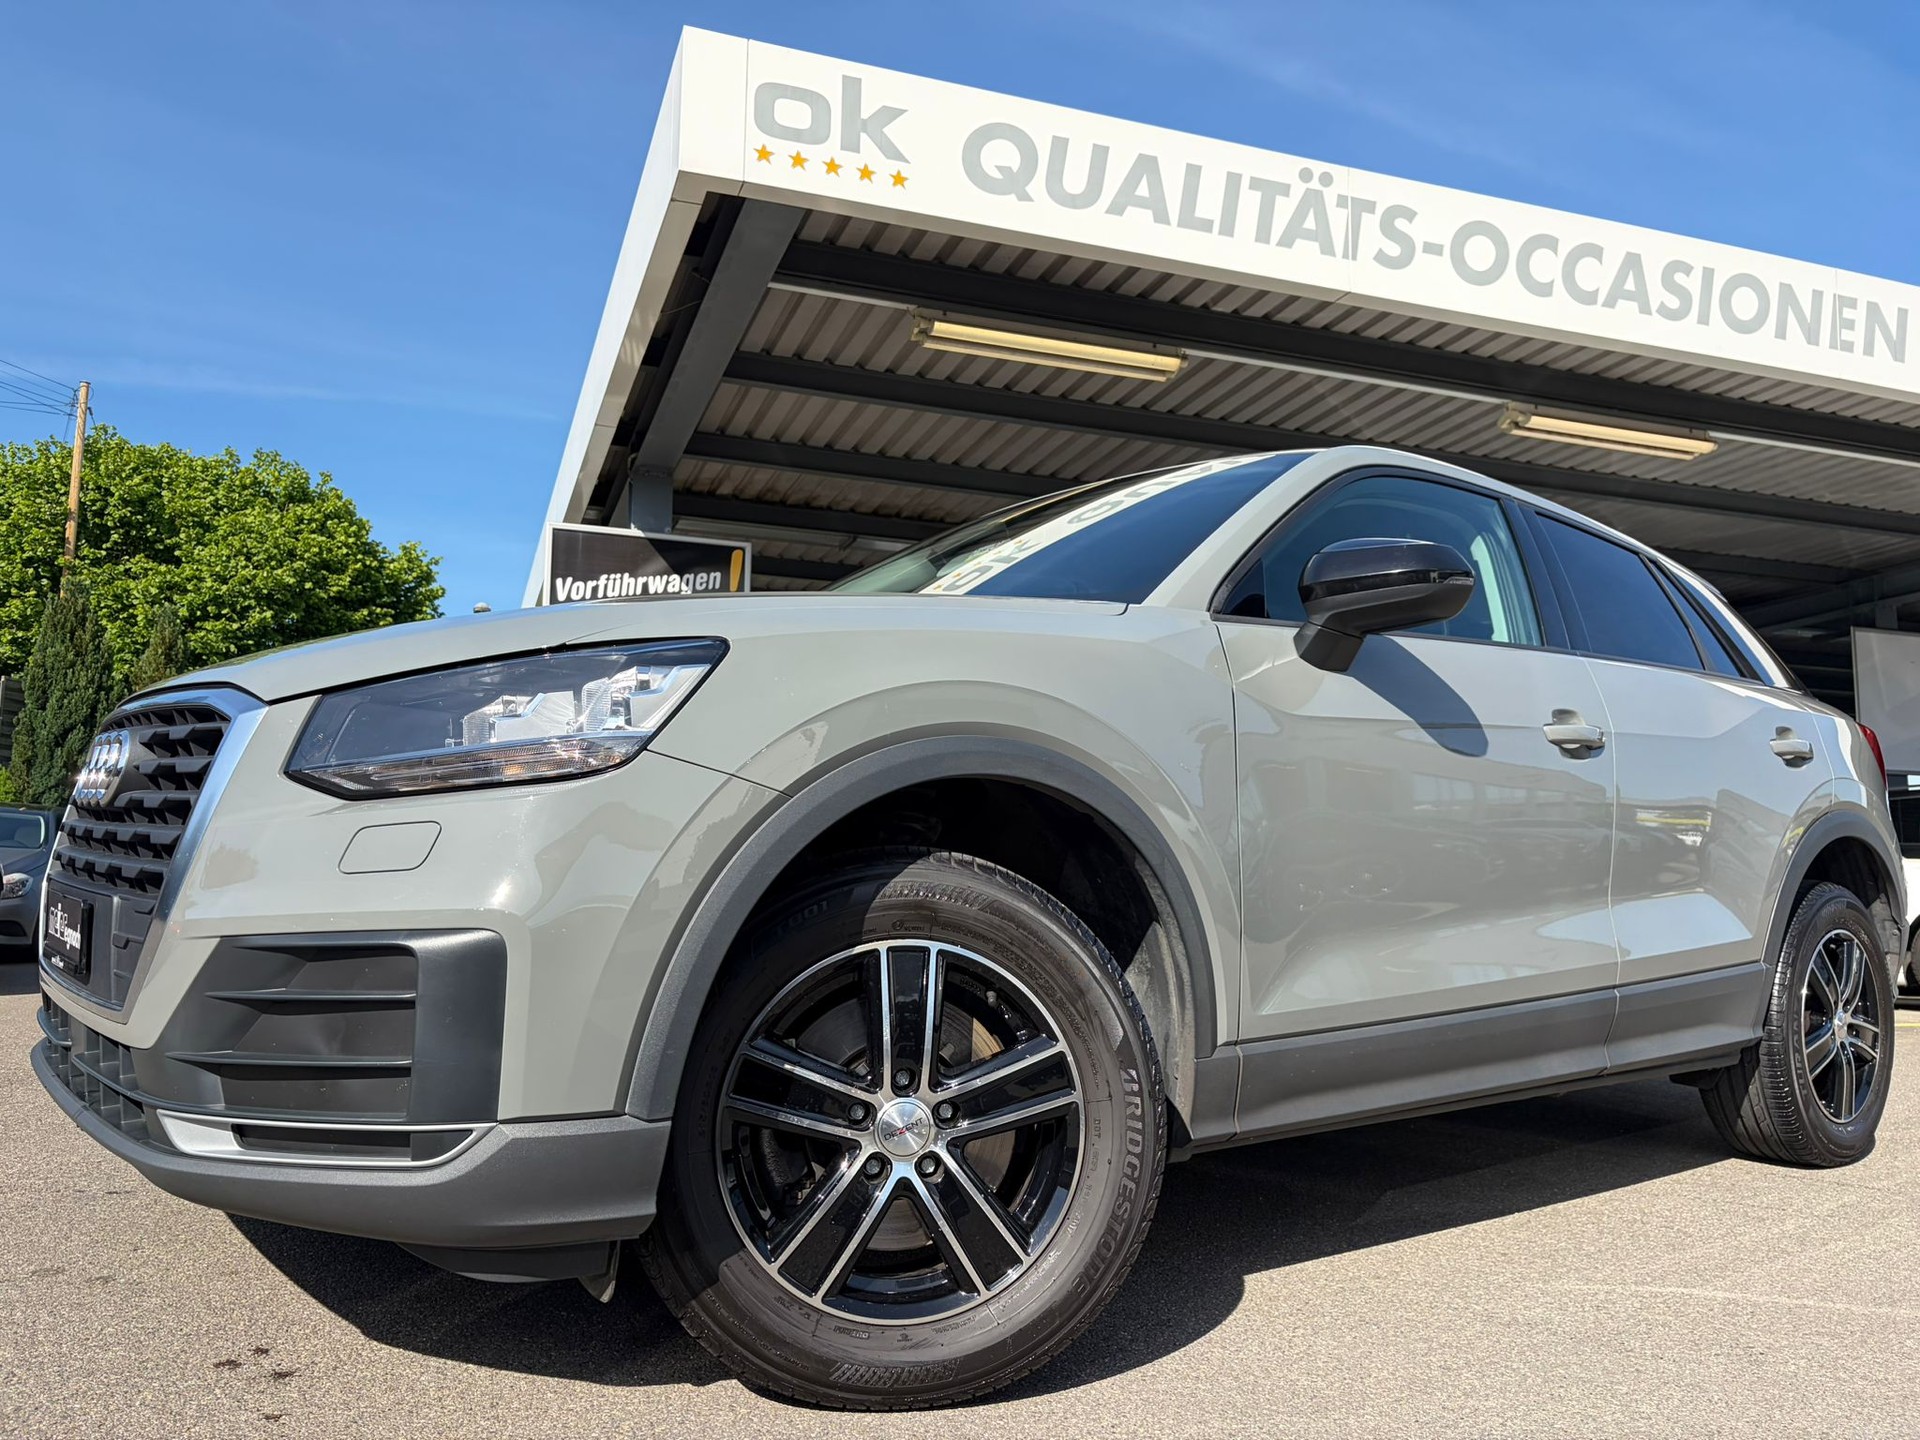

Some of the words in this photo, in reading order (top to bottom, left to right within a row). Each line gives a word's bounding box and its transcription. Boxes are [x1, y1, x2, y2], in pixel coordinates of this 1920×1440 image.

[753, 74, 911, 165] ok
[961, 122, 1909, 365] QUALITÄTS-OCCASIONEN
[555, 571, 722, 602] Vorführwagen
[883, 1117, 924, 1141] DEZENT
[1070, 1068, 1143, 1298] BRIDGESTONE
